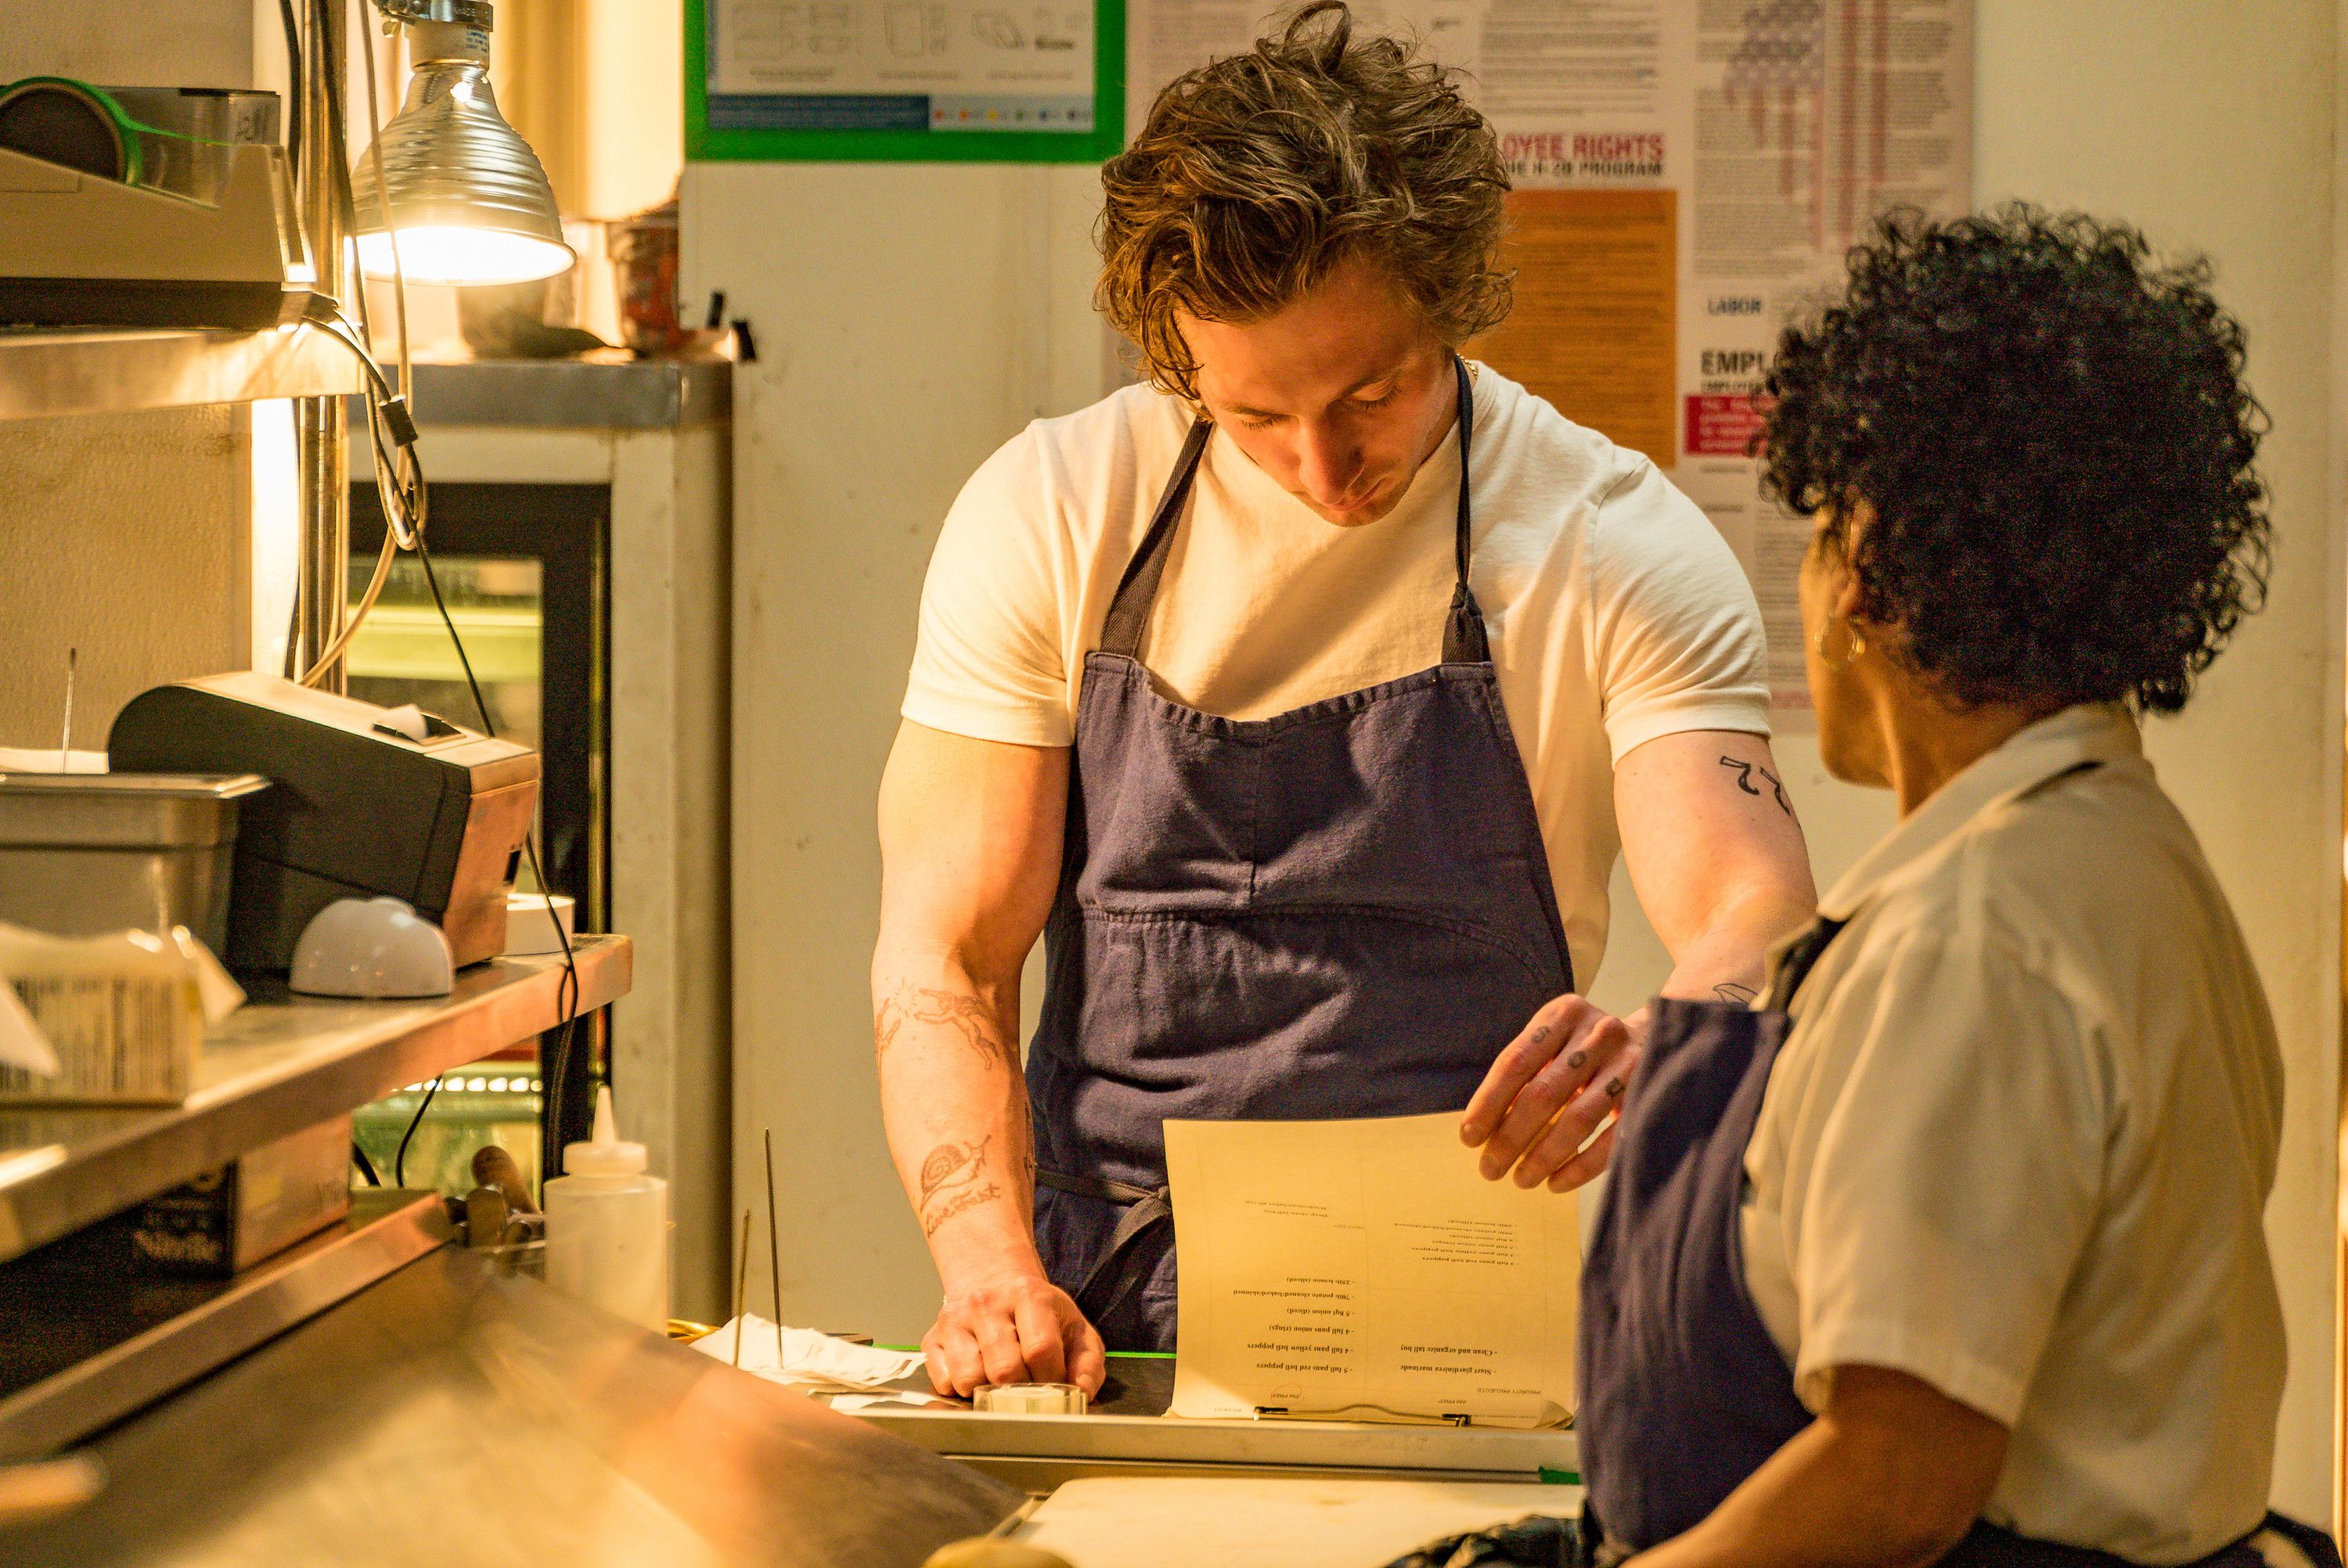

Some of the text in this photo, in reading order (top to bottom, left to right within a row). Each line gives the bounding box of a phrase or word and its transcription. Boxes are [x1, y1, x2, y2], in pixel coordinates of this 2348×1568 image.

[1502, 131, 1666, 161] OYEE RIGHTS
[1579, 161, 1663, 177] PROGRAM
[1708, 297, 1763, 316] LABOR
[1702, 350, 1767, 375] EMPL
[1720, 756, 1792, 818] 77
